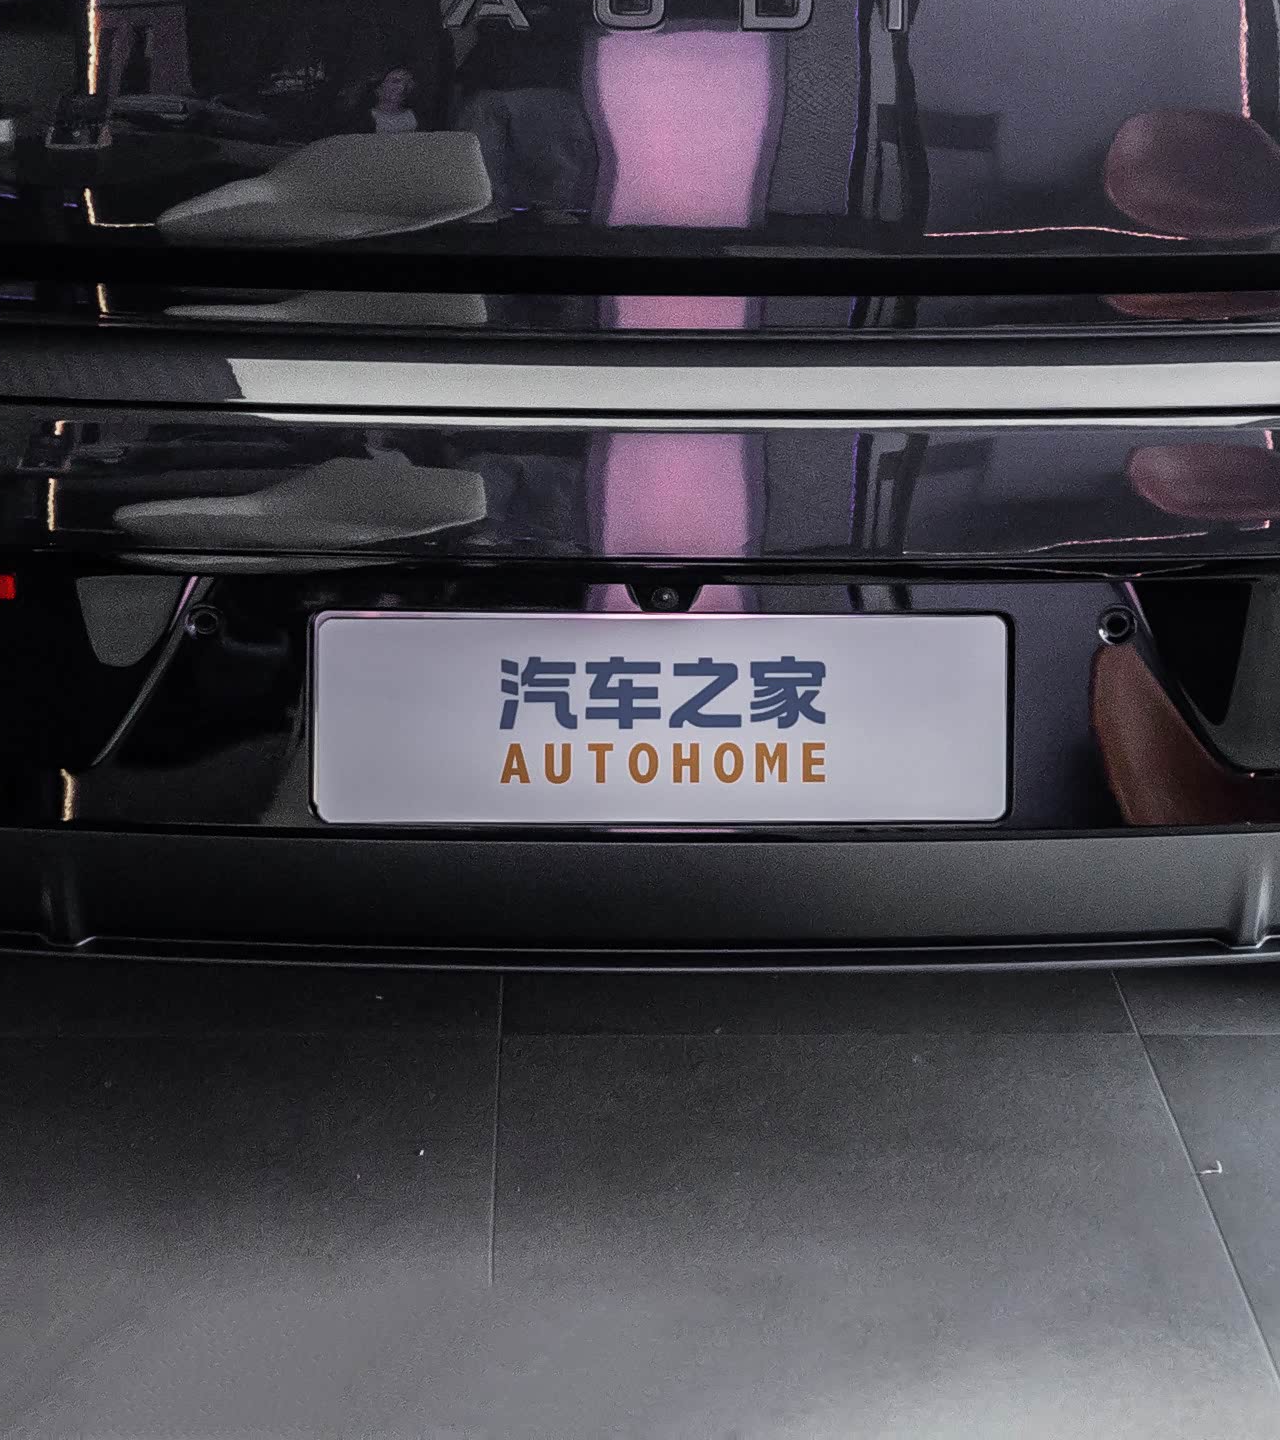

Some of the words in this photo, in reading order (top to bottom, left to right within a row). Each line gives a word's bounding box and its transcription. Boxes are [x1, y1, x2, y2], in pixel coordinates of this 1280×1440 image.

[499, 656, 826, 730] 汽车之家
[500, 742, 826, 784] AUTOHOME
